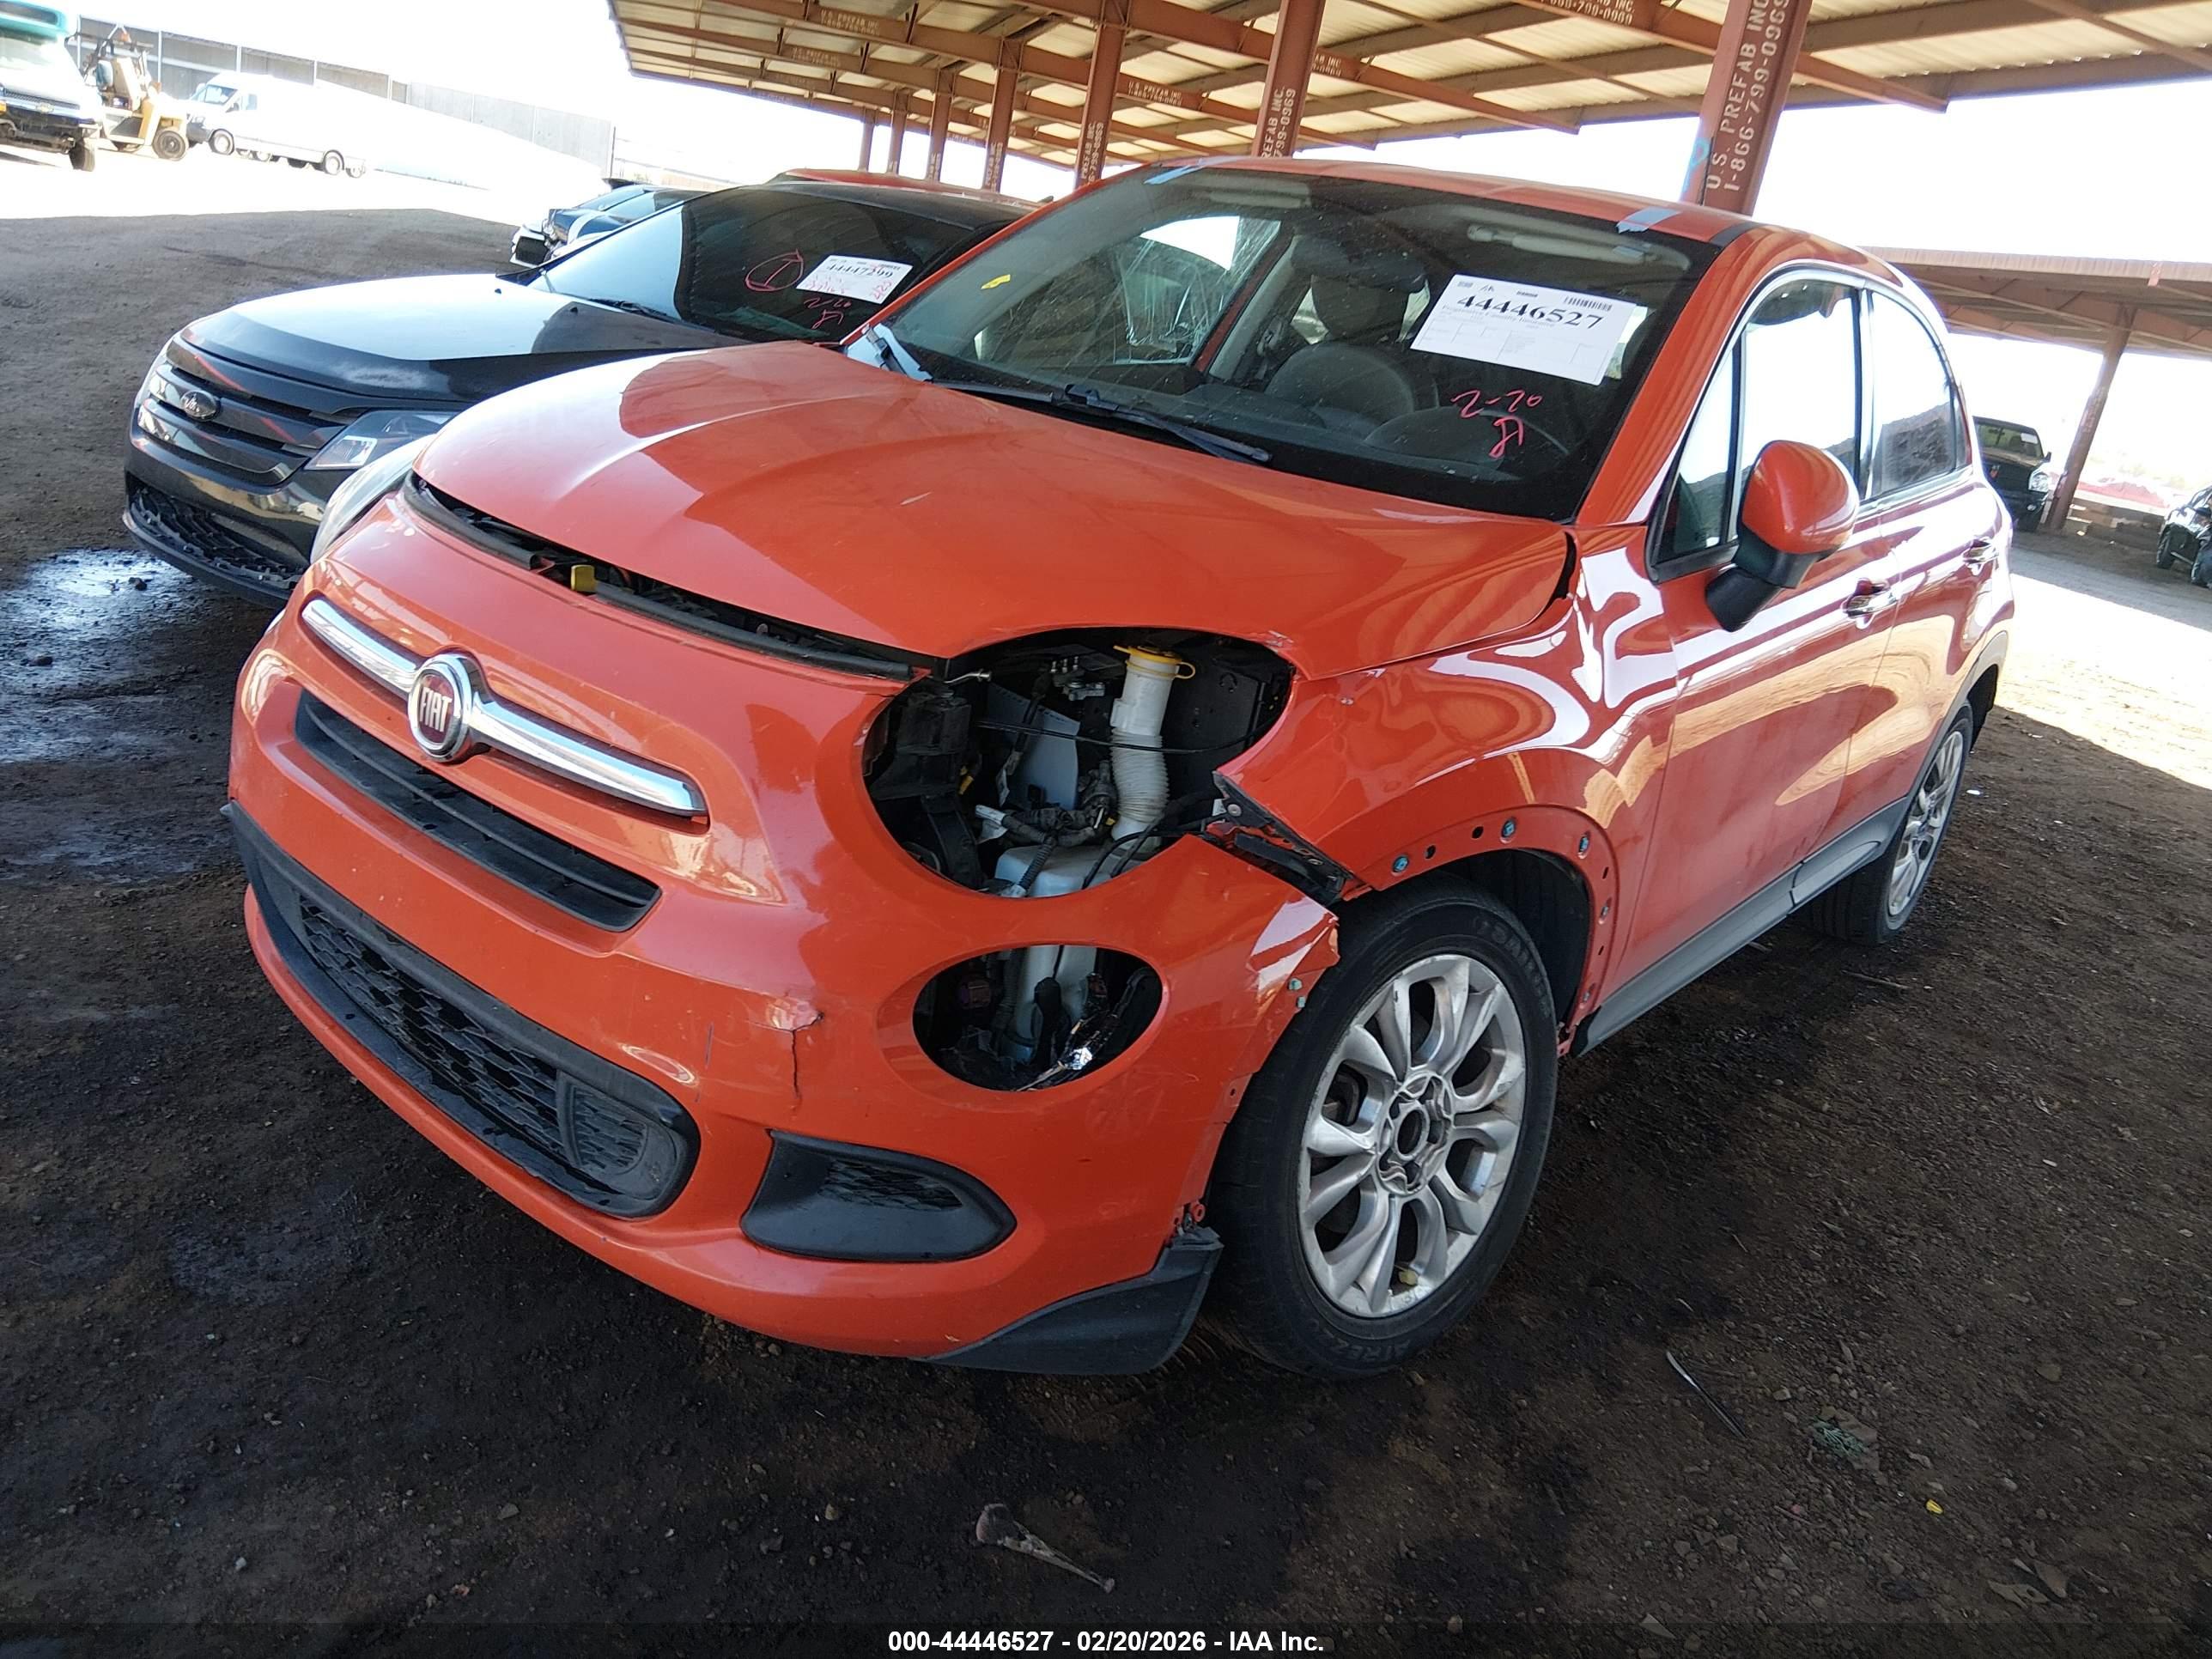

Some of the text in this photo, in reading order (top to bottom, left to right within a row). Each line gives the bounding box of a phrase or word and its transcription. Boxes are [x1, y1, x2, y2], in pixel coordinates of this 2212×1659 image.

[1720, 42, 1757, 134] PREFAB
[1457, 295, 1604, 330] 44446527
[420, 686, 453, 732] FIAT
